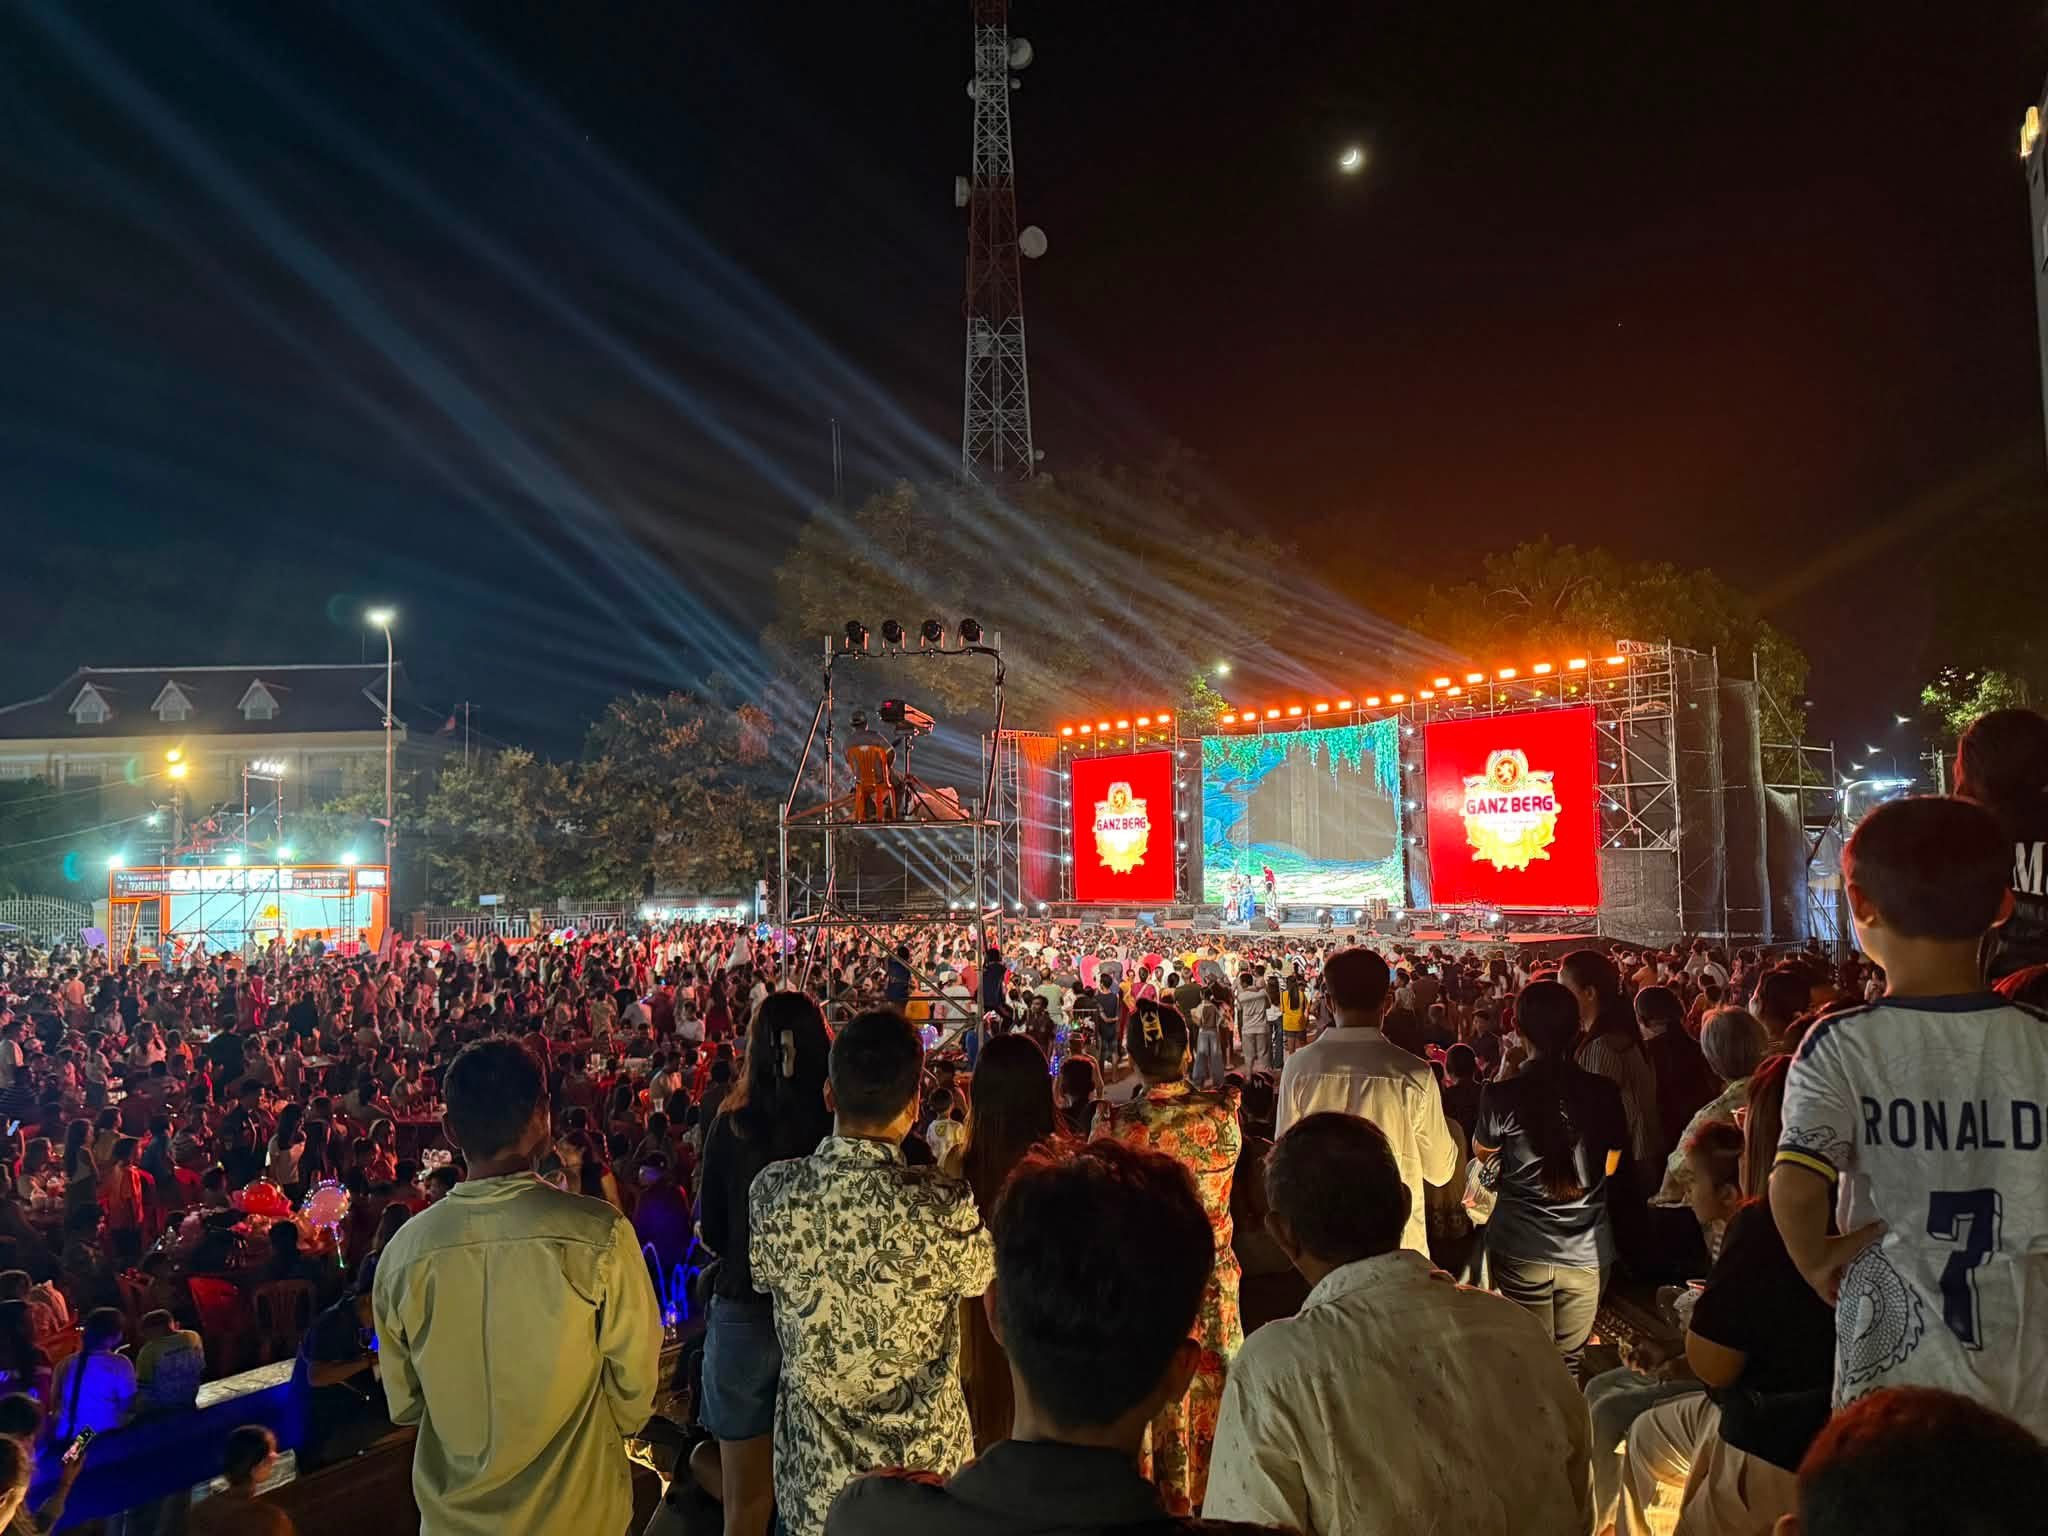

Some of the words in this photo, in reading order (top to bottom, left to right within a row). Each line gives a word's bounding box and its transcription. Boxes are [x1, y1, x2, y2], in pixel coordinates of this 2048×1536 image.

[1466, 796, 1508, 815] GANZ
[1511, 795, 1553, 813] BERG
[2011, 841, 2048, 896] M
[1860, 1096, 2048, 1151] RONALD
[1926, 1188, 2003, 1351] 7
